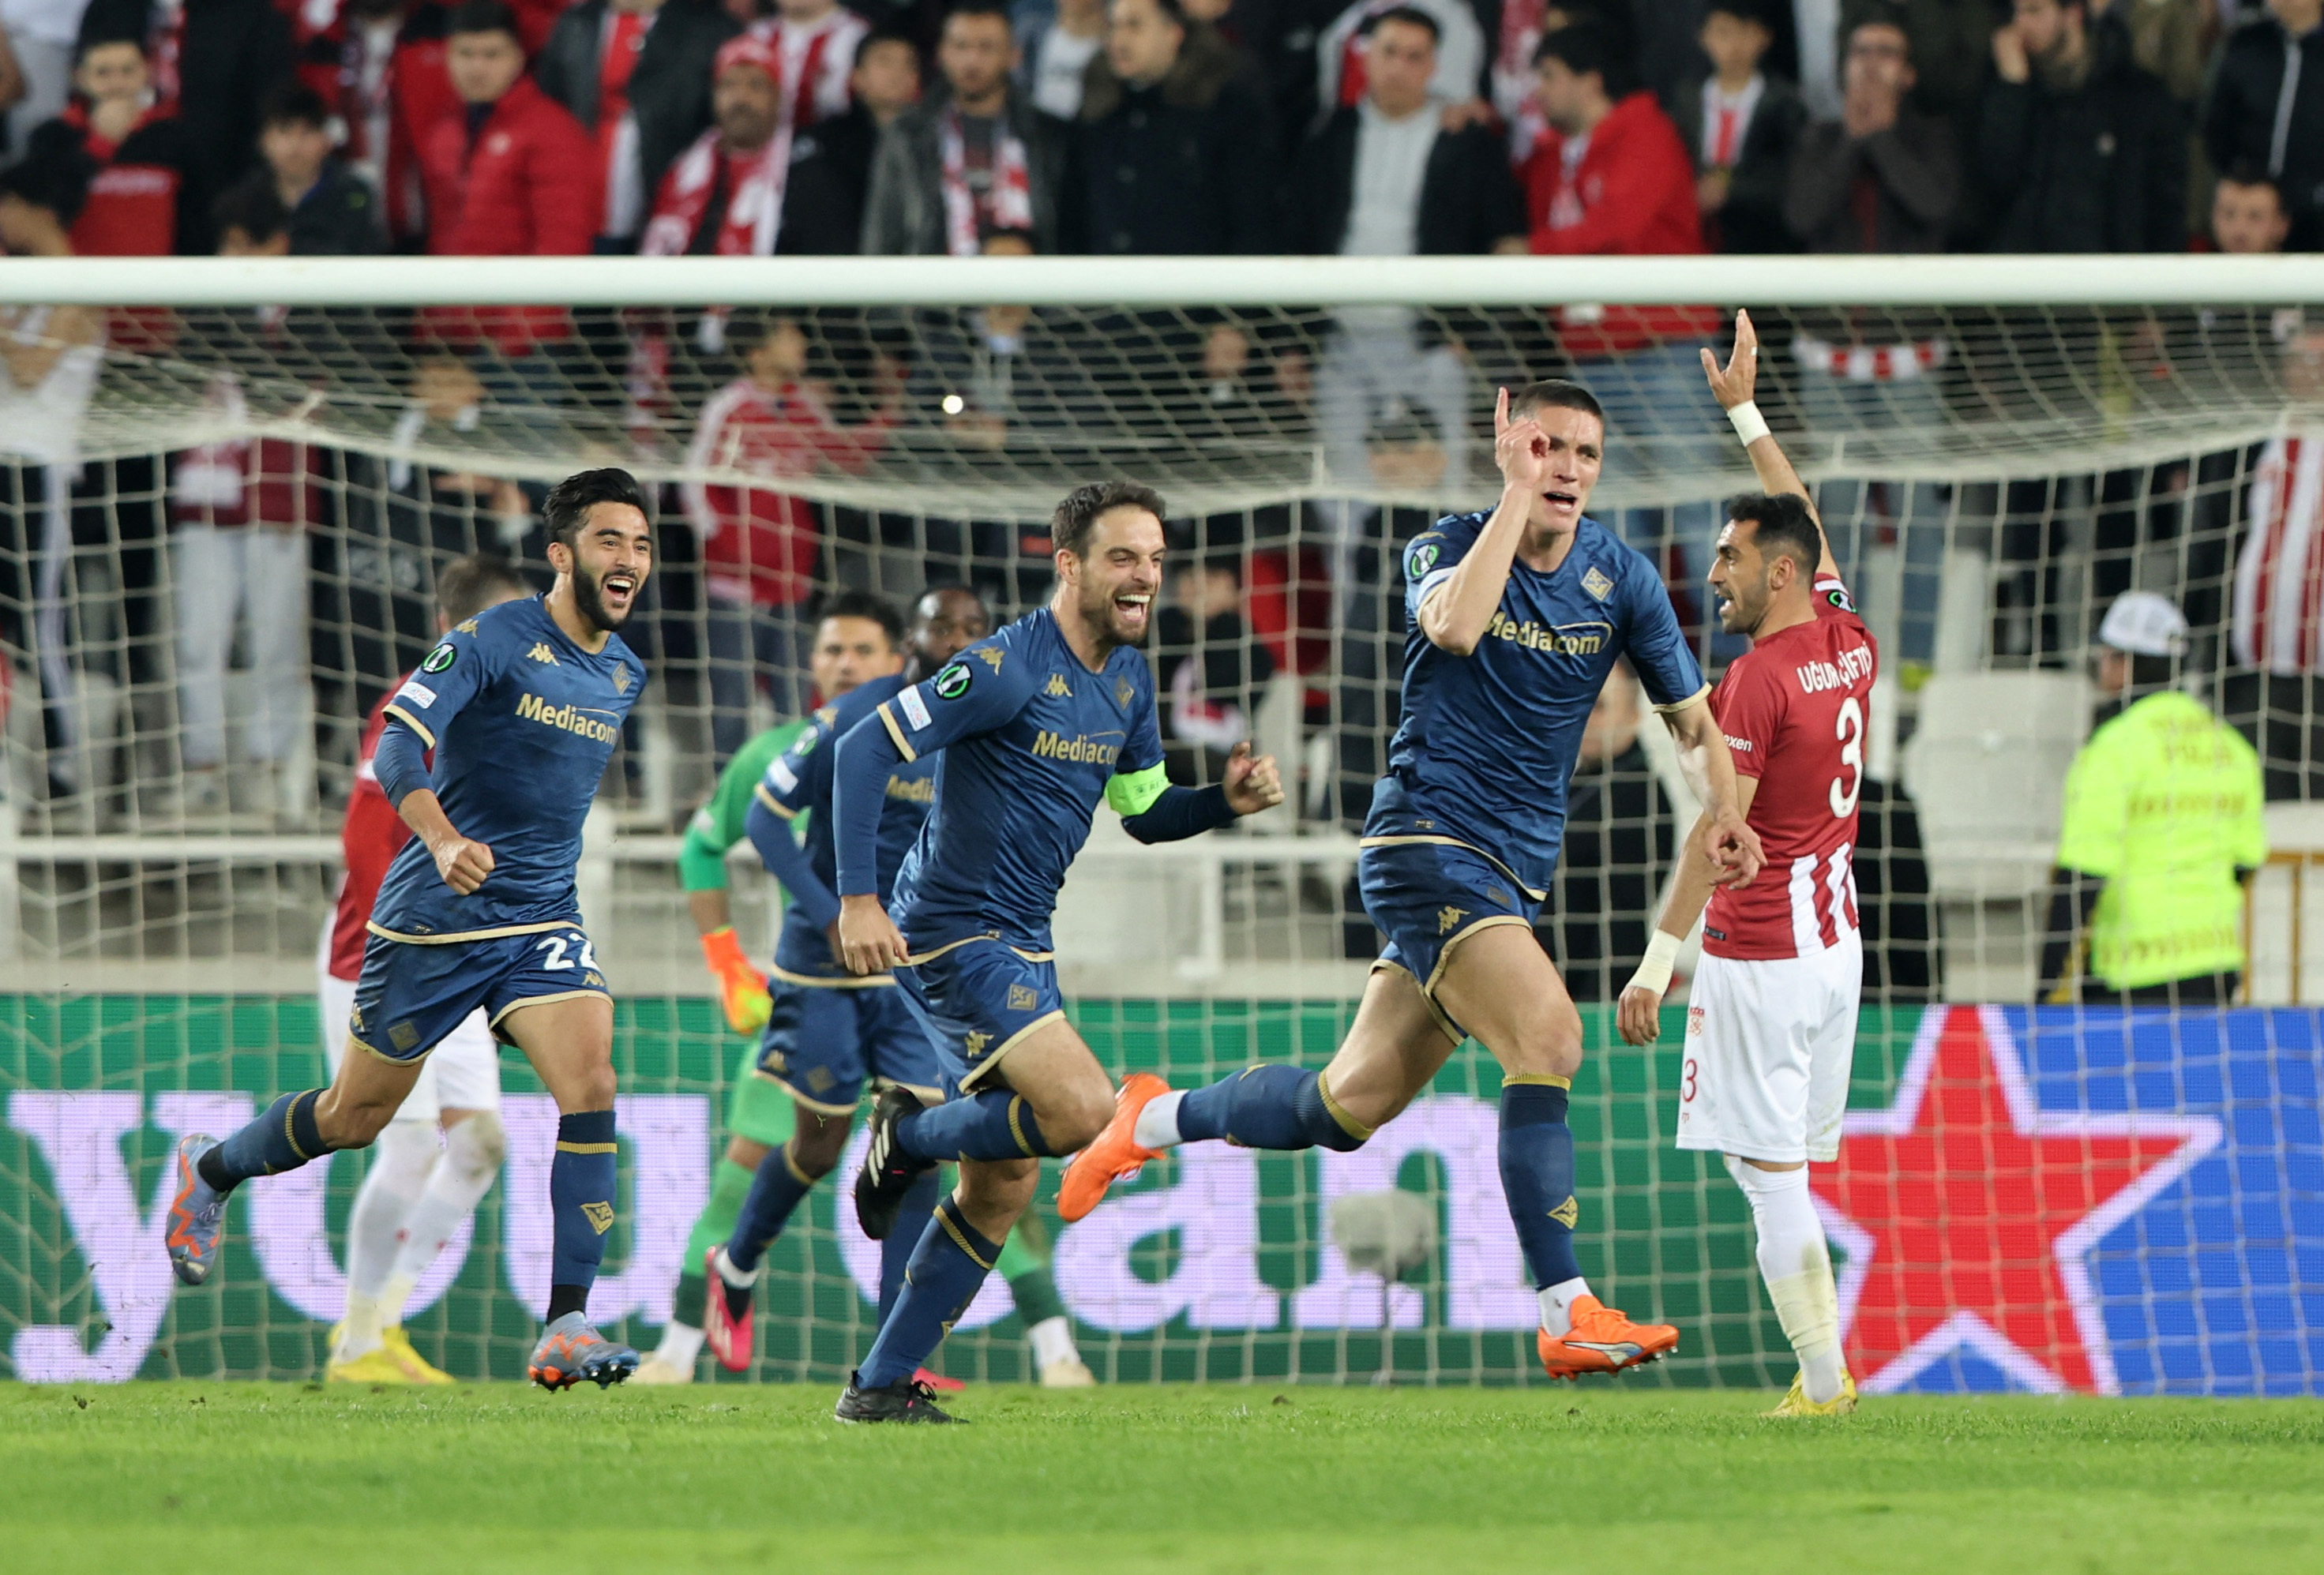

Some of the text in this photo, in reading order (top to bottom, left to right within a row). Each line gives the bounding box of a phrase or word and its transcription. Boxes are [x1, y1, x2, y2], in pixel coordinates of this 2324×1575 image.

[1797, 661, 1841, 693] UĞUR
[1723, 734, 1752, 752] exen
[1829, 696, 1863, 818] 3
[886, 774, 936, 802] Medi
[536, 932, 601, 971] 22
[1683, 1059, 1697, 1102] 3
